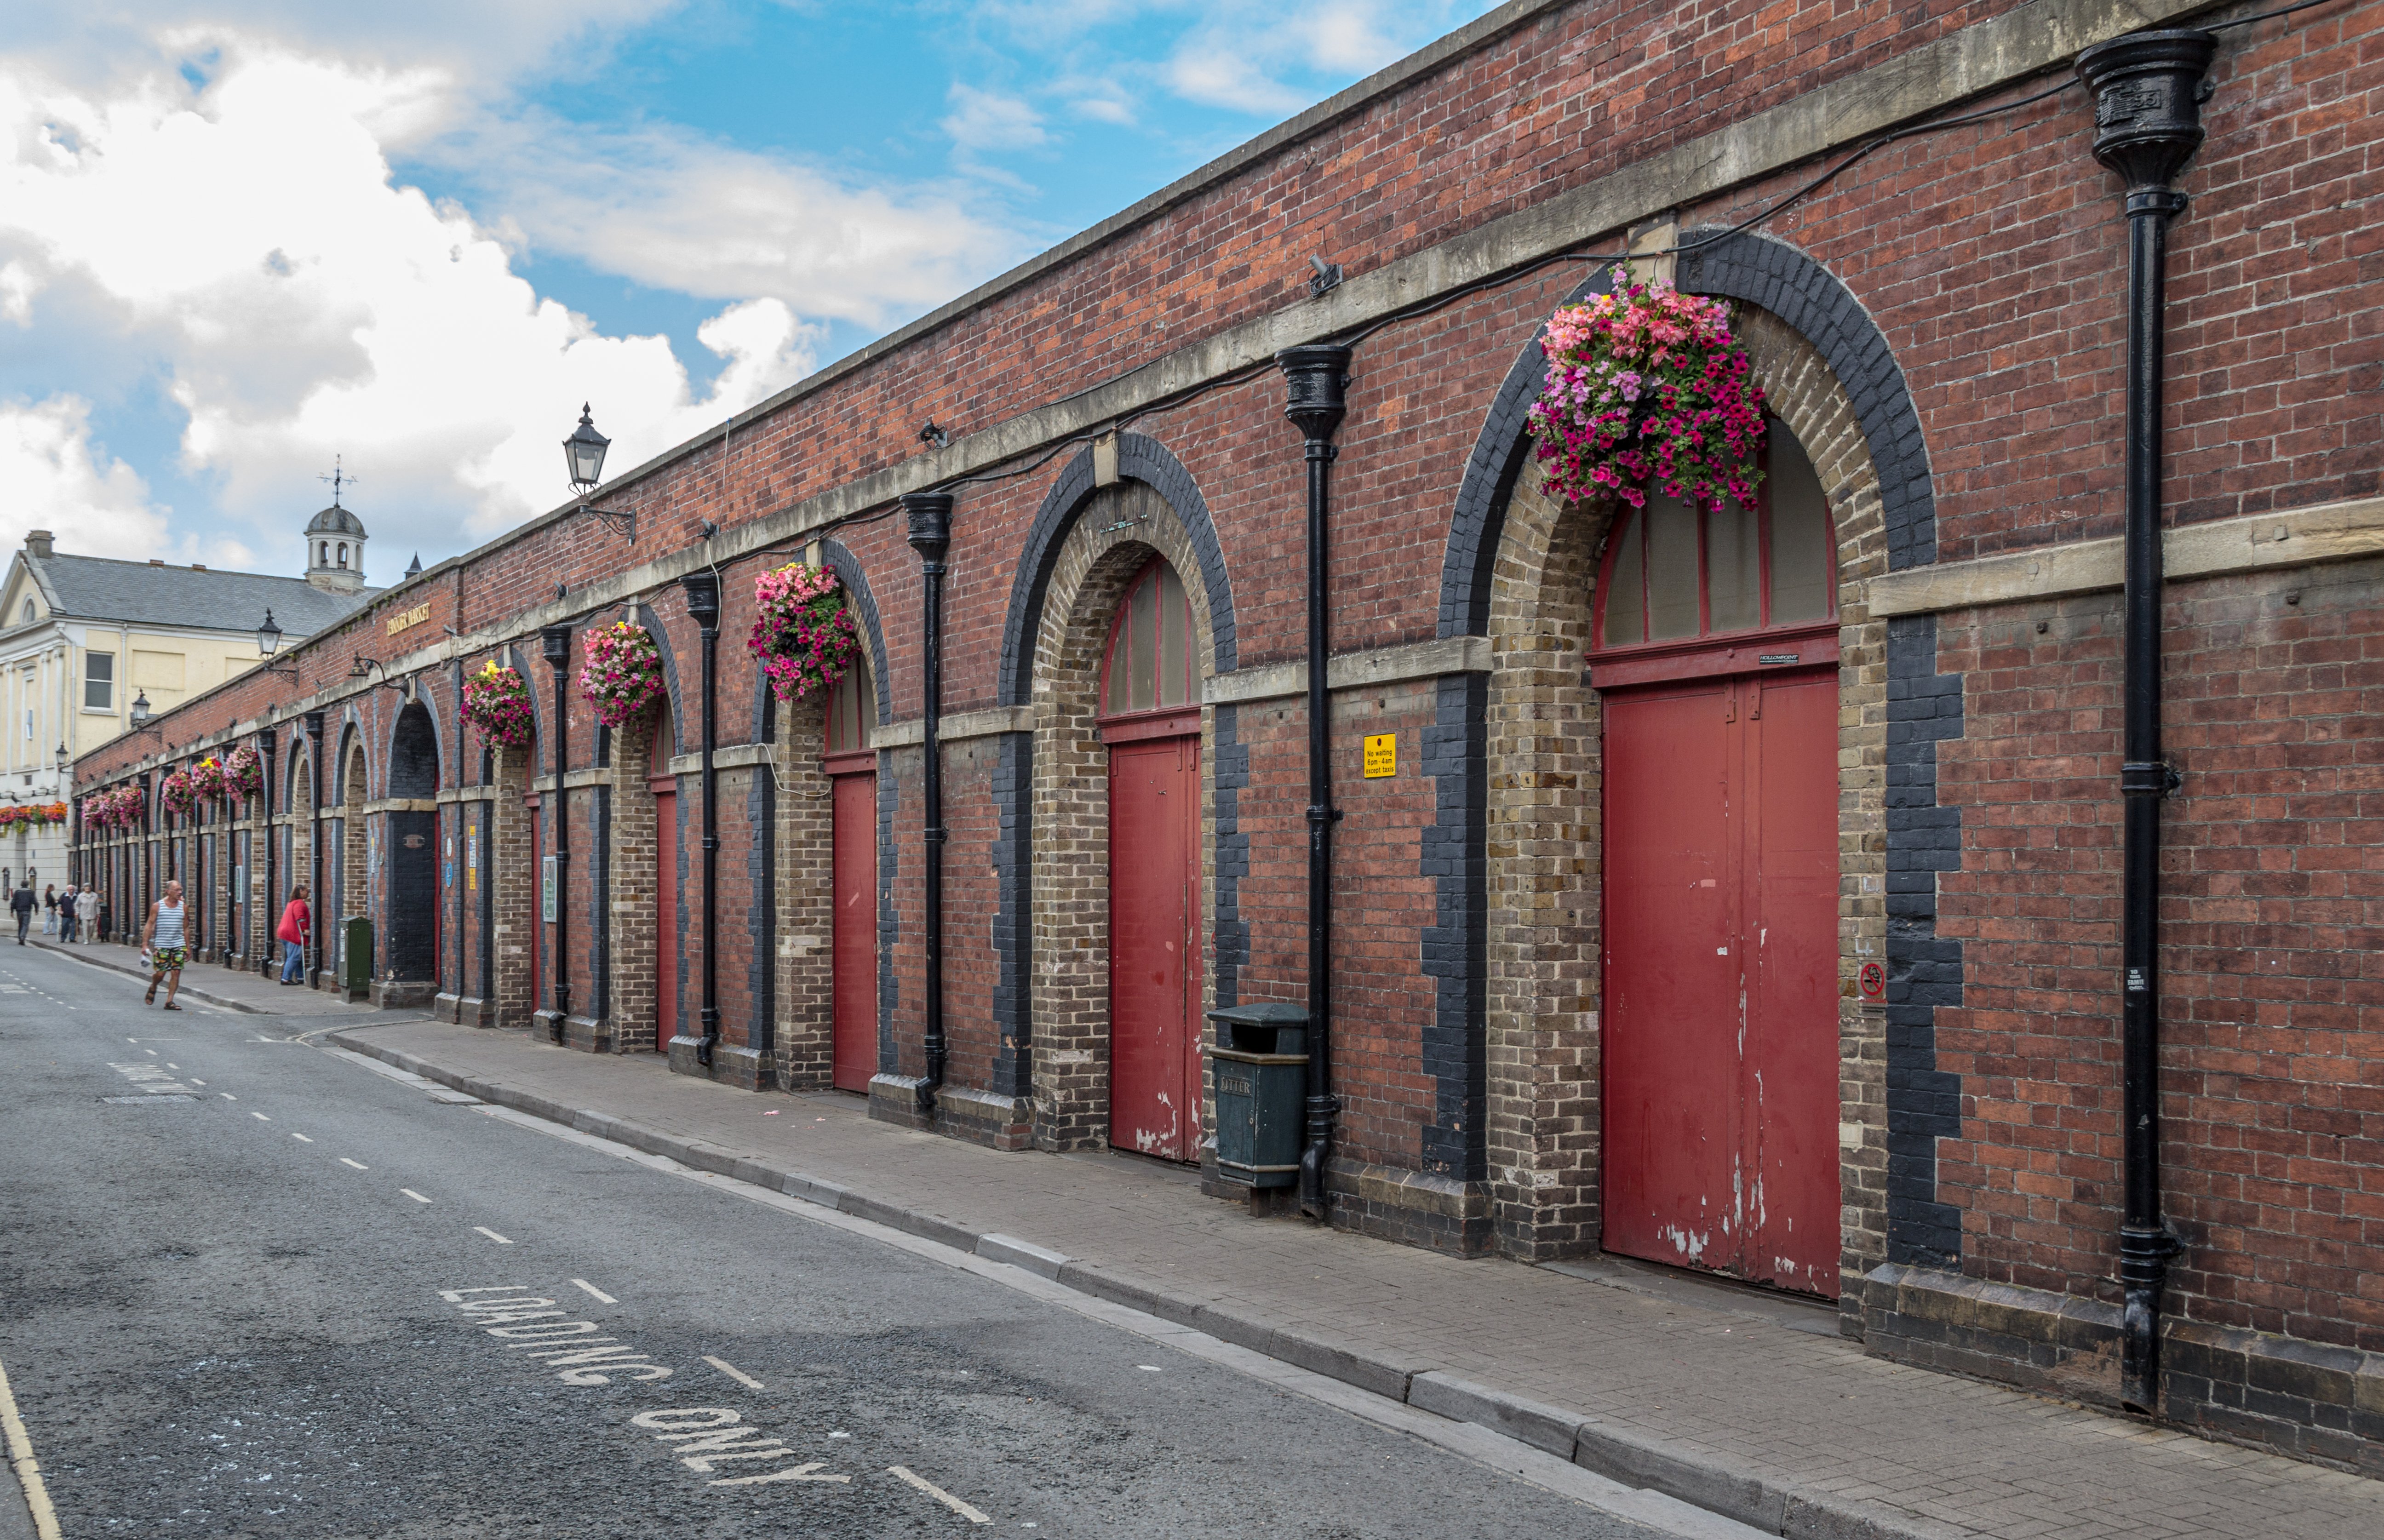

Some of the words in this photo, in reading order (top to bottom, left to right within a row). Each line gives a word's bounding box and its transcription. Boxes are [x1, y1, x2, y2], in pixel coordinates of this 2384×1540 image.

[407, 602, 430, 627] MARKET
[1855, 938, 1874, 956] 4
[1220, 1076, 1250, 1094] LITTER
[437, 1285, 674, 1386] LOADING
[629, 1407, 852, 1487] ONLY
